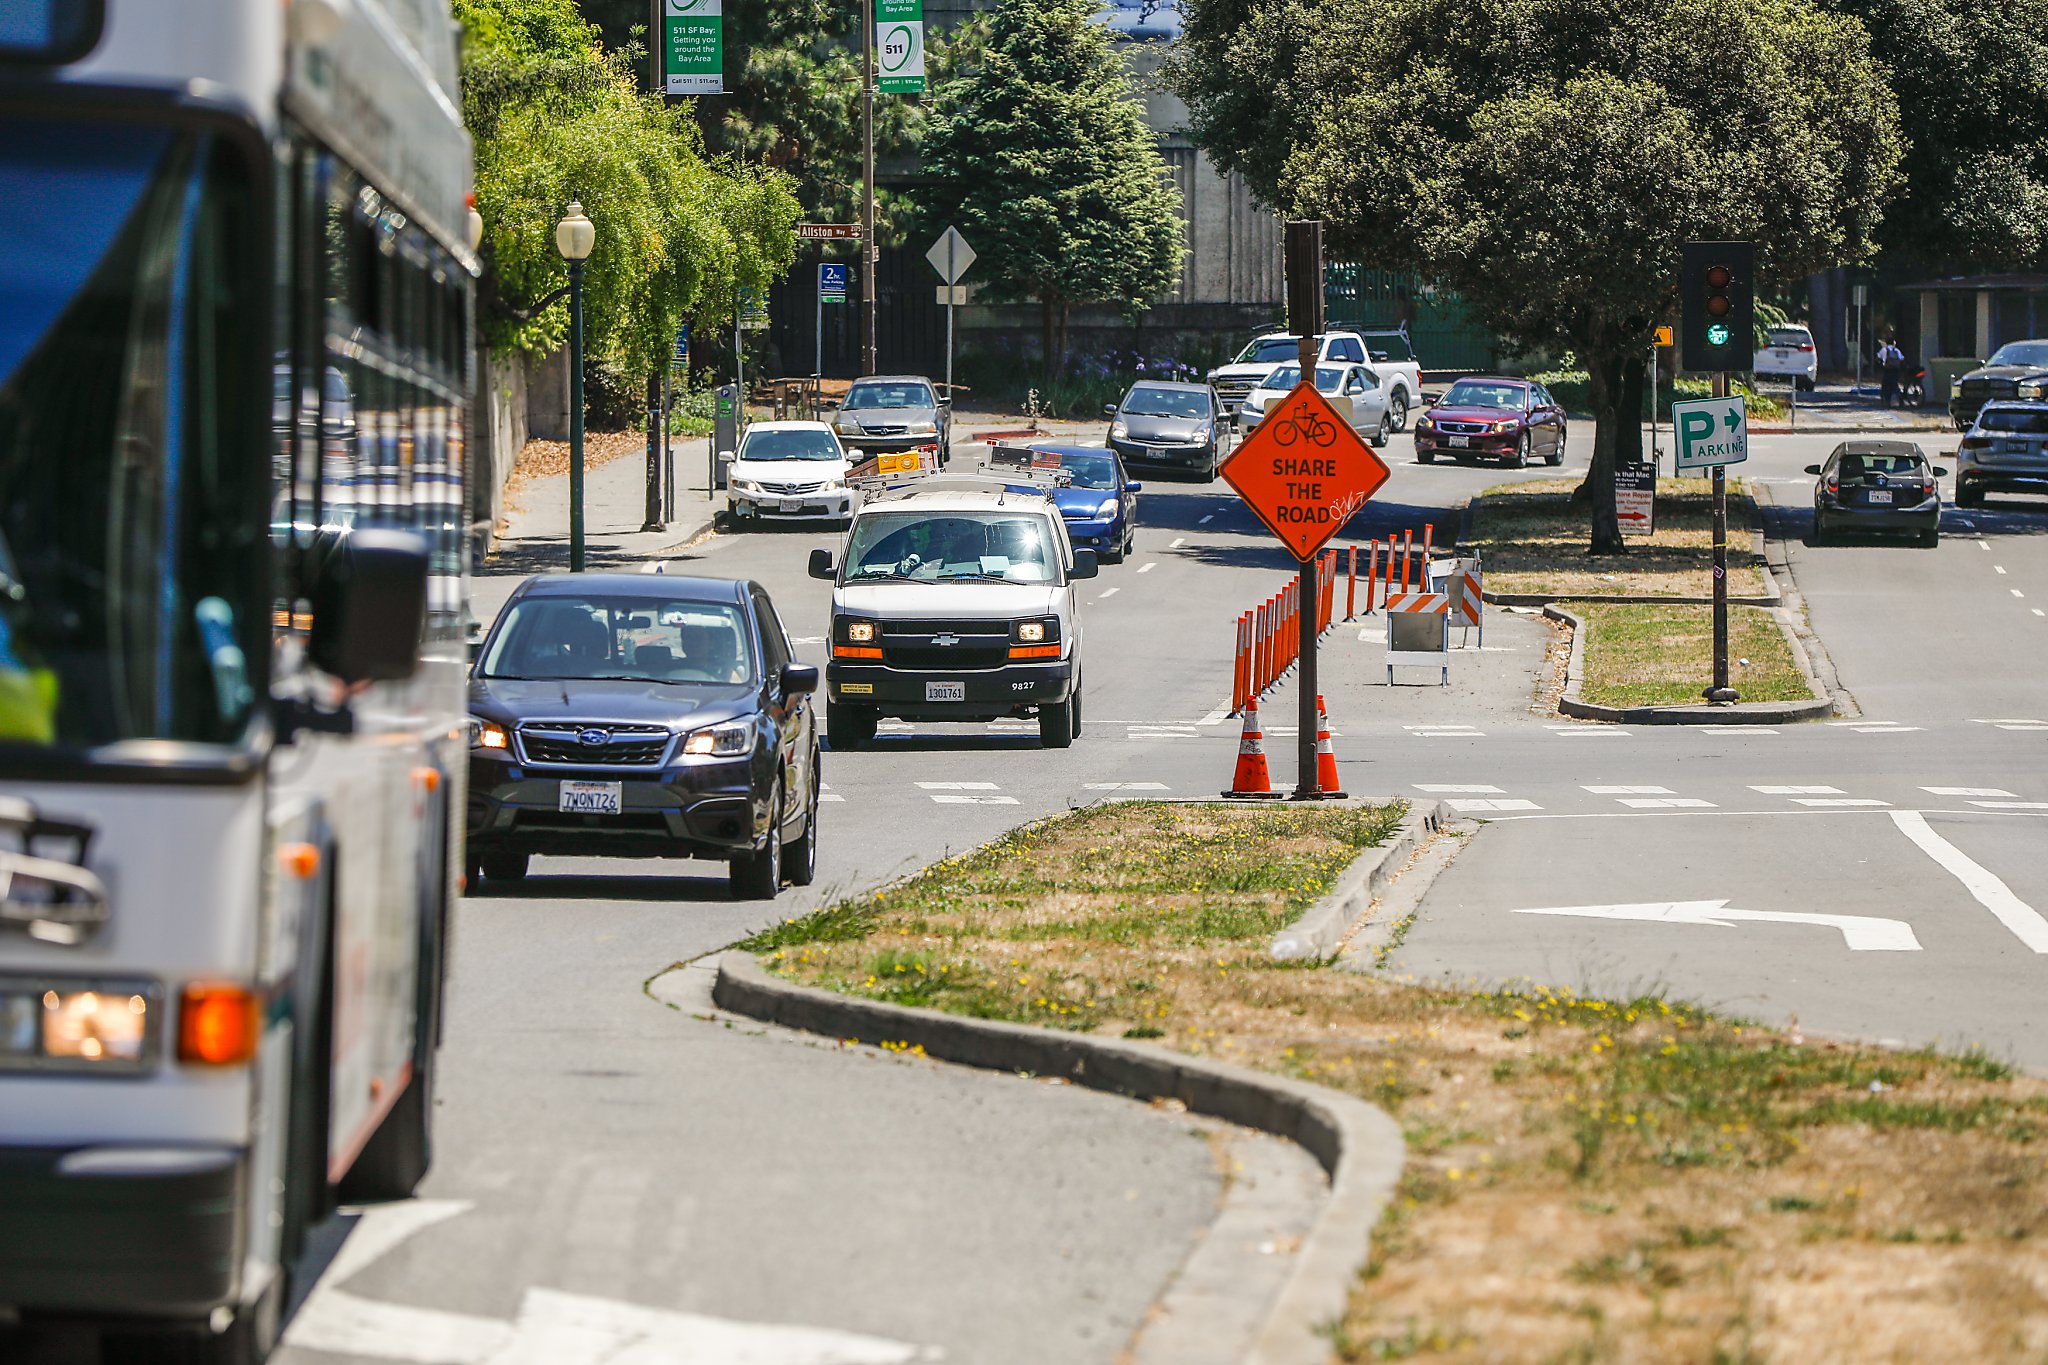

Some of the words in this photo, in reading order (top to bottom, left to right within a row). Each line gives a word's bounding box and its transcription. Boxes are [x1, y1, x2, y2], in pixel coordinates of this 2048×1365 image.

[886, 45, 902, 54] 511
[802, 226, 833, 237] Allston
[1272, 458, 1336, 476] SHARE
[1286, 483, 1322, 500] THE
[1277, 506, 1330, 523] ROAD
[1012, 682, 1035, 690] 9827
[929, 688, 962, 698] 1301761
